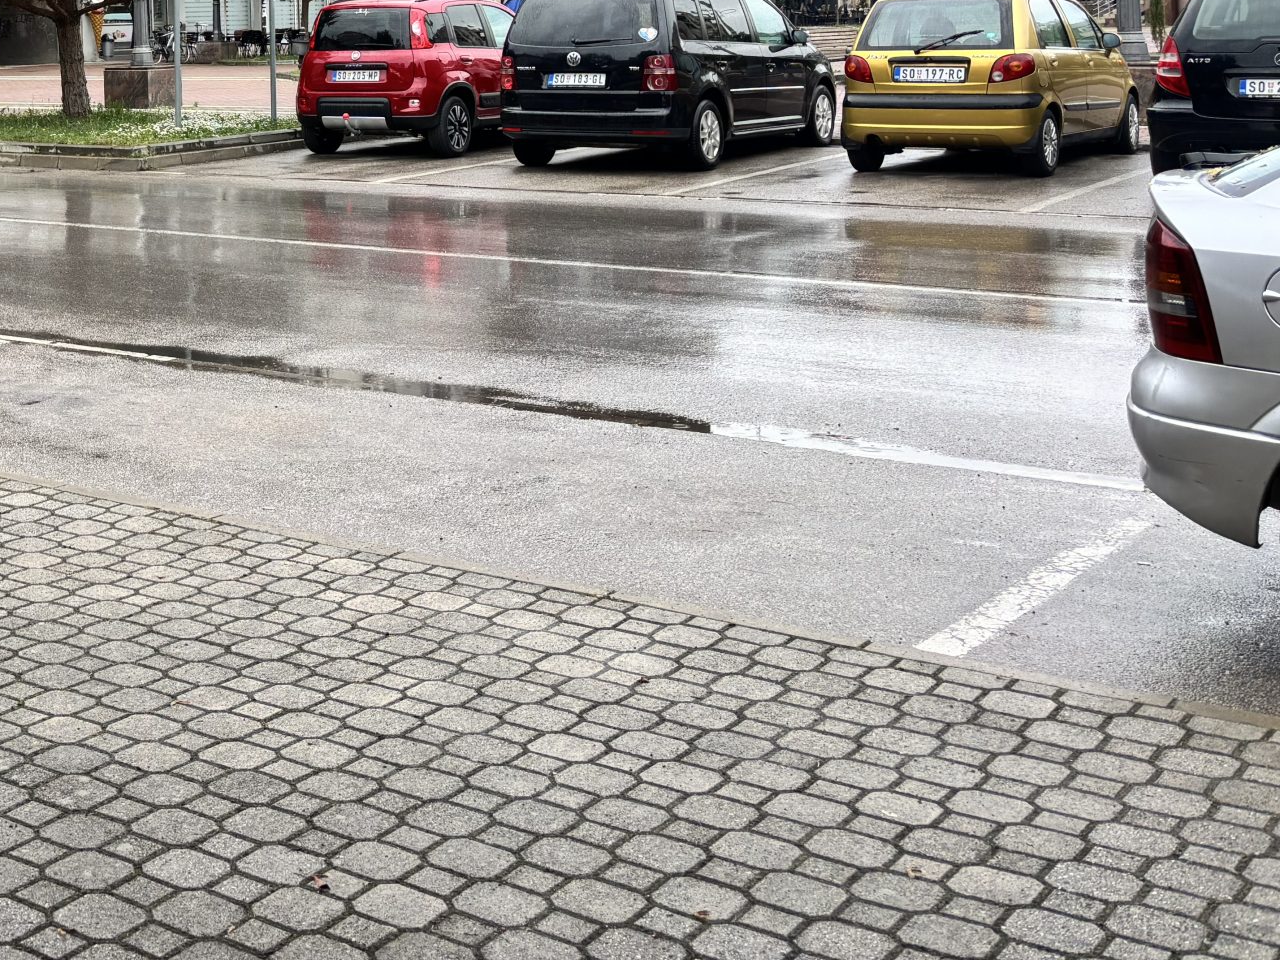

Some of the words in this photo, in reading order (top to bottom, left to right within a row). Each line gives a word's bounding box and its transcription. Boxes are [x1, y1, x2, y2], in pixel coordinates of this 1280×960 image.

[337, 71, 347, 80] SO
[902, 68, 916, 79] SO
[554, 74, 565, 84] SO
[1248, 81, 1265, 93] SO
